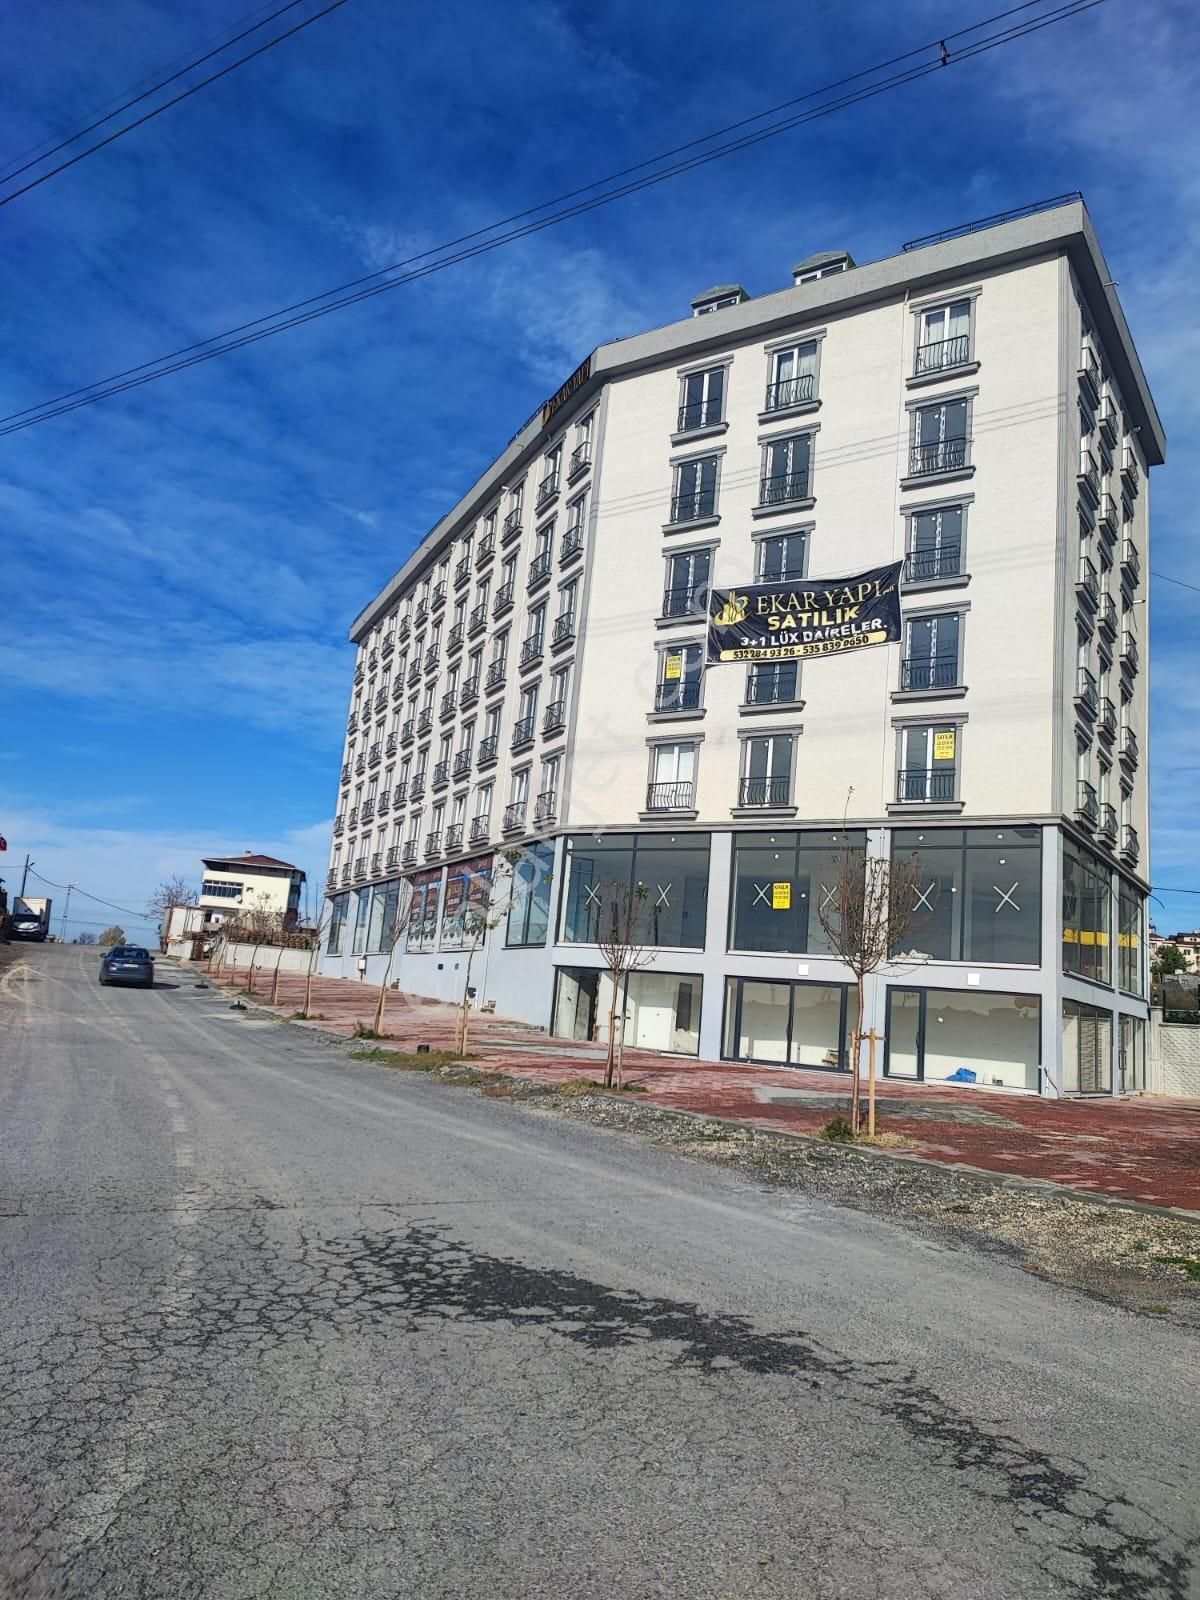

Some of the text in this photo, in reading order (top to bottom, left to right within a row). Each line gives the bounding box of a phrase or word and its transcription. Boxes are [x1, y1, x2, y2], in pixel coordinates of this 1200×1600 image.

[756, 593, 820, 615] EKAR
[823, 581, 882, 604] YAPI
[768, 605, 860, 631] SATILIK
[733, 651, 749, 659] 532
[750, 649, 767, 658] 284
[770, 648, 782, 657] 93
[783, 647, 795, 656] 26
[803, 645, 820, 655] 535
[822, 641, 841, 652] 839
[842, 635, 869, 648] 0650
[740, 637, 765, 647] 3+1
[770, 630, 799, 646] LÜX
